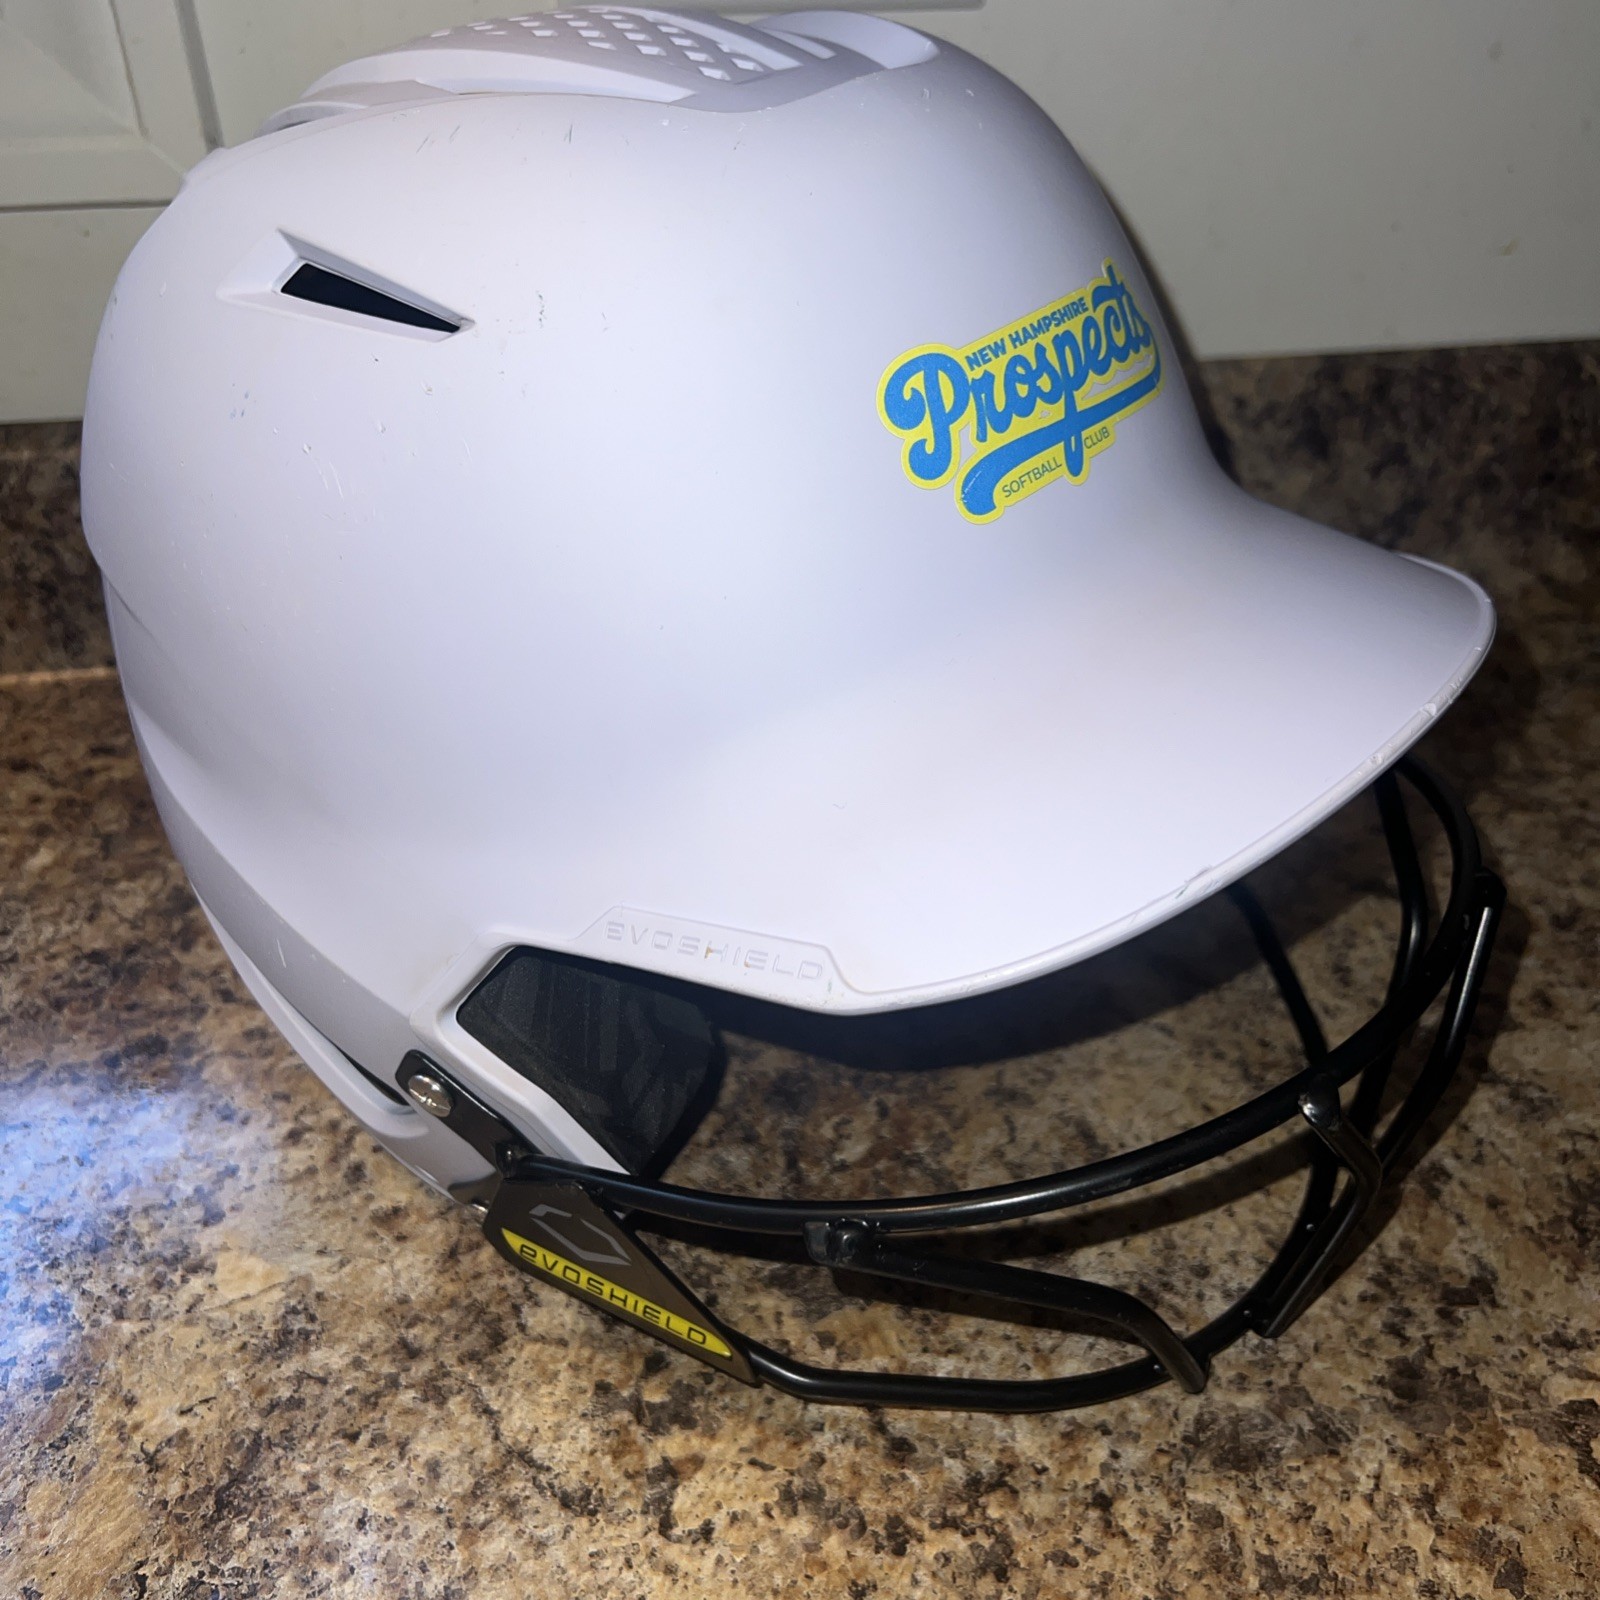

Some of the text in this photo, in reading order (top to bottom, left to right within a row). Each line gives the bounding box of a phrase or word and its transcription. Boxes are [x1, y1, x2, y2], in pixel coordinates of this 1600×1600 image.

[964, 297, 1089, 372] NEW HAMPSHIRE
[884, 265, 1161, 481] Prospects
[1002, 427, 1110, 498] SOFTBALL CLUB
